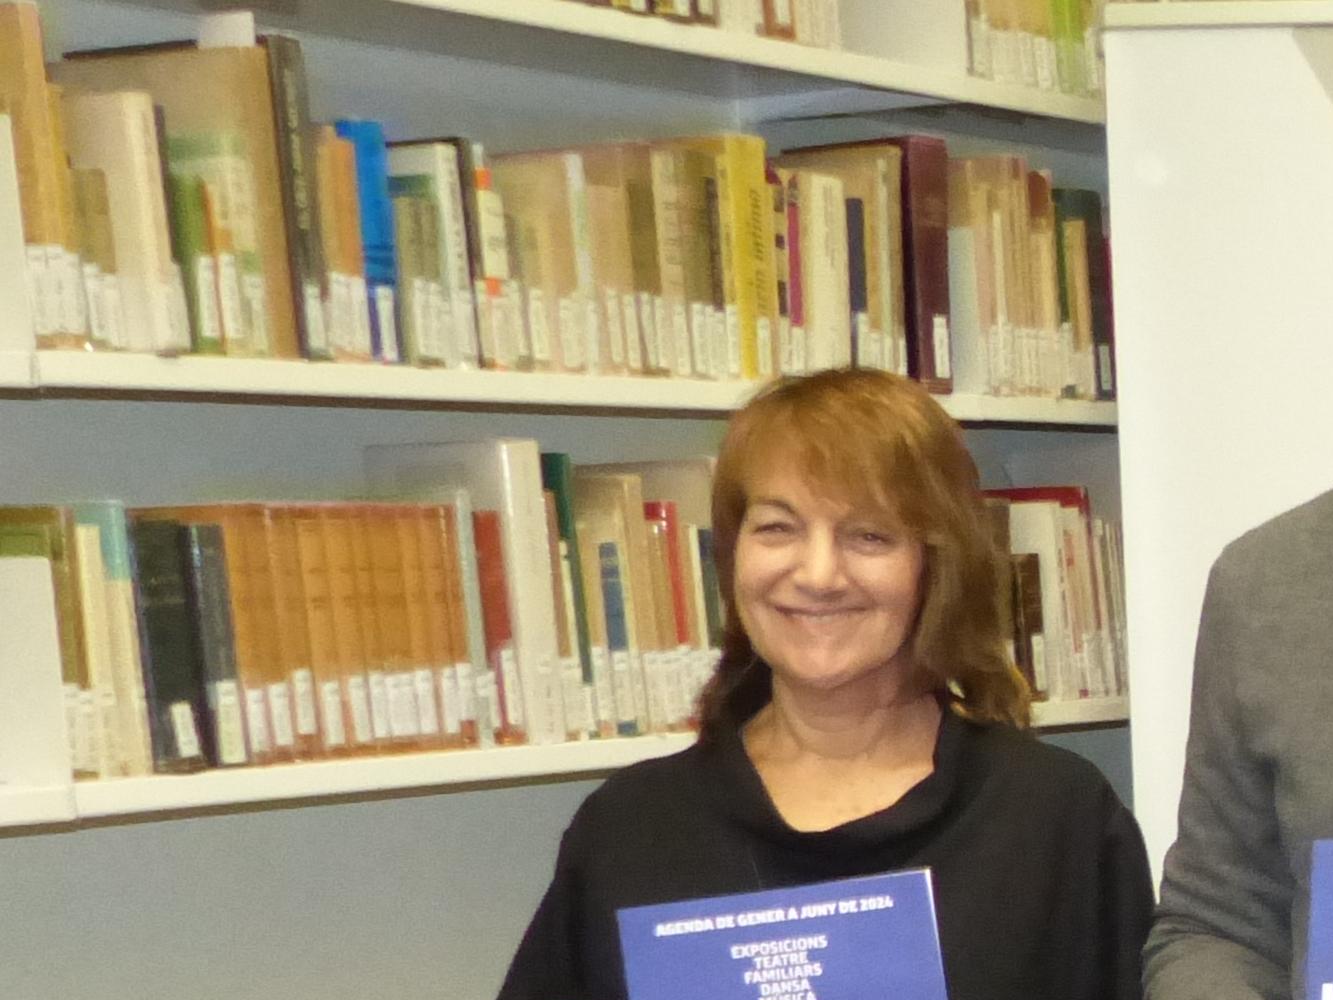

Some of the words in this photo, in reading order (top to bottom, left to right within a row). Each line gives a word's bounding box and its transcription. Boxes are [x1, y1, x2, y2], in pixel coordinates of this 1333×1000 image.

[655, 916, 713, 936] AGENDA
[716, 914, 735, 930] DE
[738, 908, 786, 928] GENER
[787, 906, 798, 920] A
[800, 903, 836, 919] JUNY
[838, 900, 858, 914] DE
[860, 896, 893, 911] 2024
[730, 935, 827, 959] EXPOSICIONS
[755, 952, 808, 970] TEATRE
[744, 963, 822, 984] FAMILIARS
[760, 979, 810, 996] DANSA
